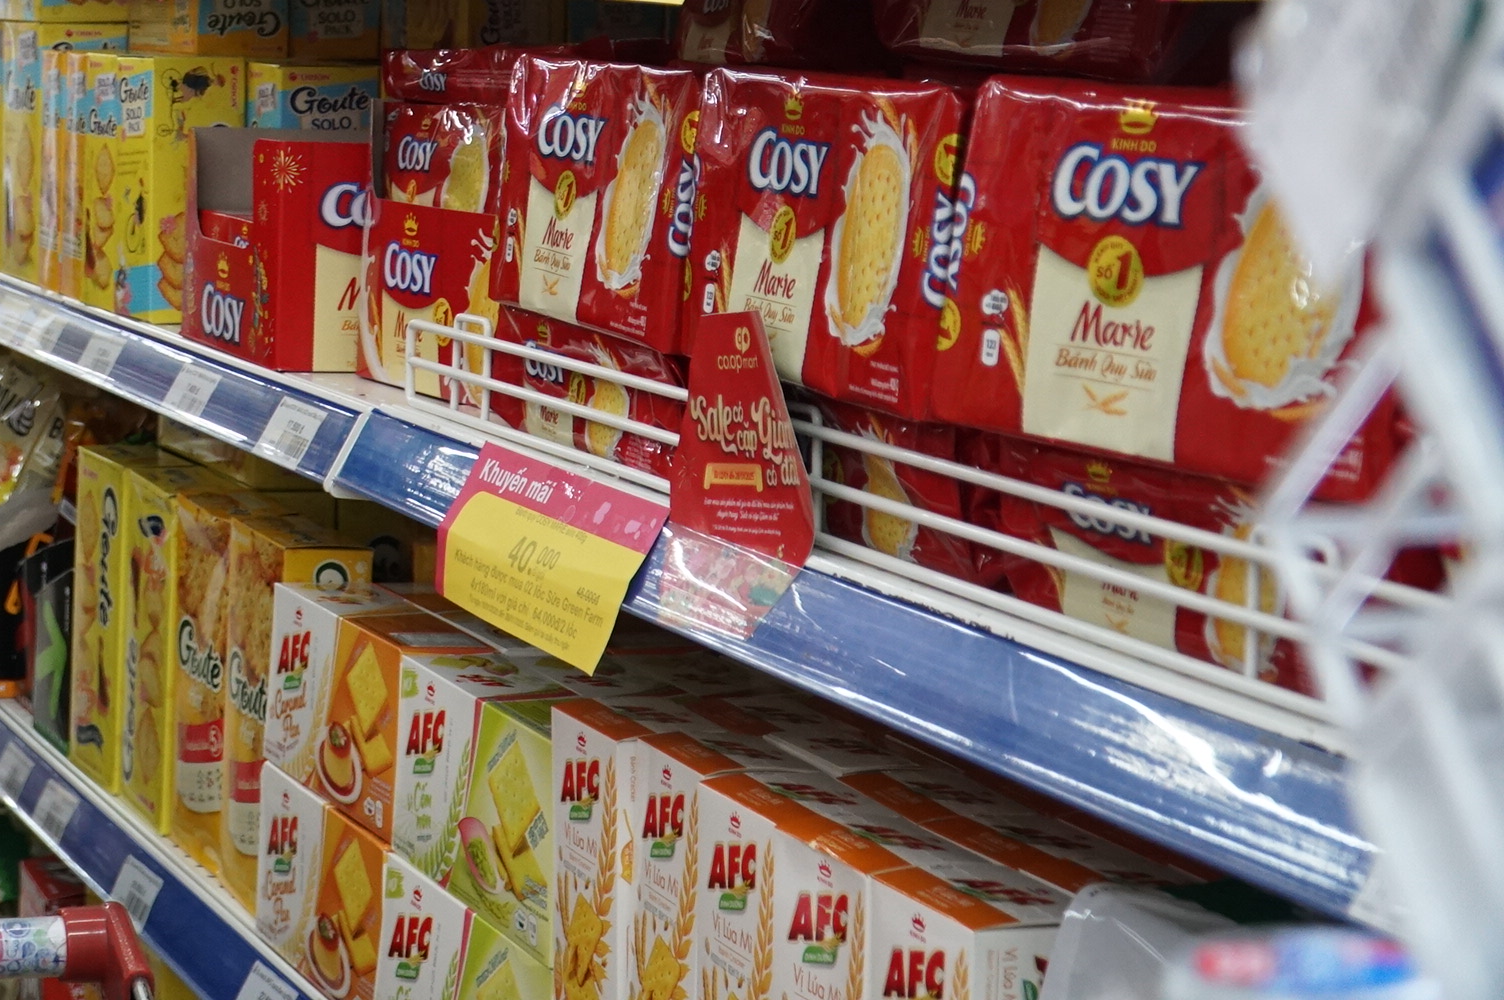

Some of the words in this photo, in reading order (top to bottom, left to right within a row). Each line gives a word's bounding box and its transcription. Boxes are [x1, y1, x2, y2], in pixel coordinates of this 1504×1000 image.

[318, 10, 356, 24] SOLO
[289, 85, 370, 115] Gouté
[419, 72, 447, 92] COSY
[311, 116, 352, 131] SOLO
[538, 105, 605, 162] COSY
[1111, 138, 1139, 151] KINH
[398, 135, 438, 172] COSY
[748, 129, 829, 196] COSY
[322, 183, 365, 227] CO
[1053, 144, 1199, 225] COSY
[542, 216, 575, 251] Marie
[384, 242, 437, 295] COSY
[534, 251, 551, 266] Bánh
[551, 254, 562, 271] Quy
[753, 258, 797, 300] Marie
[201, 283, 244, 344] COSY
[763, 304, 779, 324] Quy
[1070, 300, 1155, 351] Marie
[1055, 348, 1098, 369] Bánh
[1100, 352, 1128, 383] Quy
[1129, 356, 1158, 383] Sữa
[690, 394, 738, 457] Sale
[732, 401, 744, 423] có
[736, 421, 758, 458] cặp
[479, 458, 528, 495] Khuyến
[525, 480, 557, 504] mãi
[766, 464, 777, 487] có
[509, 575, 524, 591] mua
[561, 595, 584, 617] Green
[583, 606, 605, 628] Farm
[178, 615, 222, 691] Gouté
[277, 630, 311, 675] AFC
[405, 709, 446, 756] AFC
[560, 758, 600, 803] AFC
[267, 815, 298, 856] AFC
[641, 793, 685, 839] AFC
[572, 829, 585, 848] Lúa
[652, 863, 666, 890] Lúa
[707, 843, 757, 890] AFC
[387, 915, 433, 961] AFC
[712, 910, 722, 938] Vị
[723, 915, 738, 944] Lúa
[739, 929, 753, 953] Mì
[787, 893, 849, 943] AFC
[793, 962, 805, 992] Vị
[806, 971, 827, 998] Lúa
[883, 949, 946, 999] AFC
